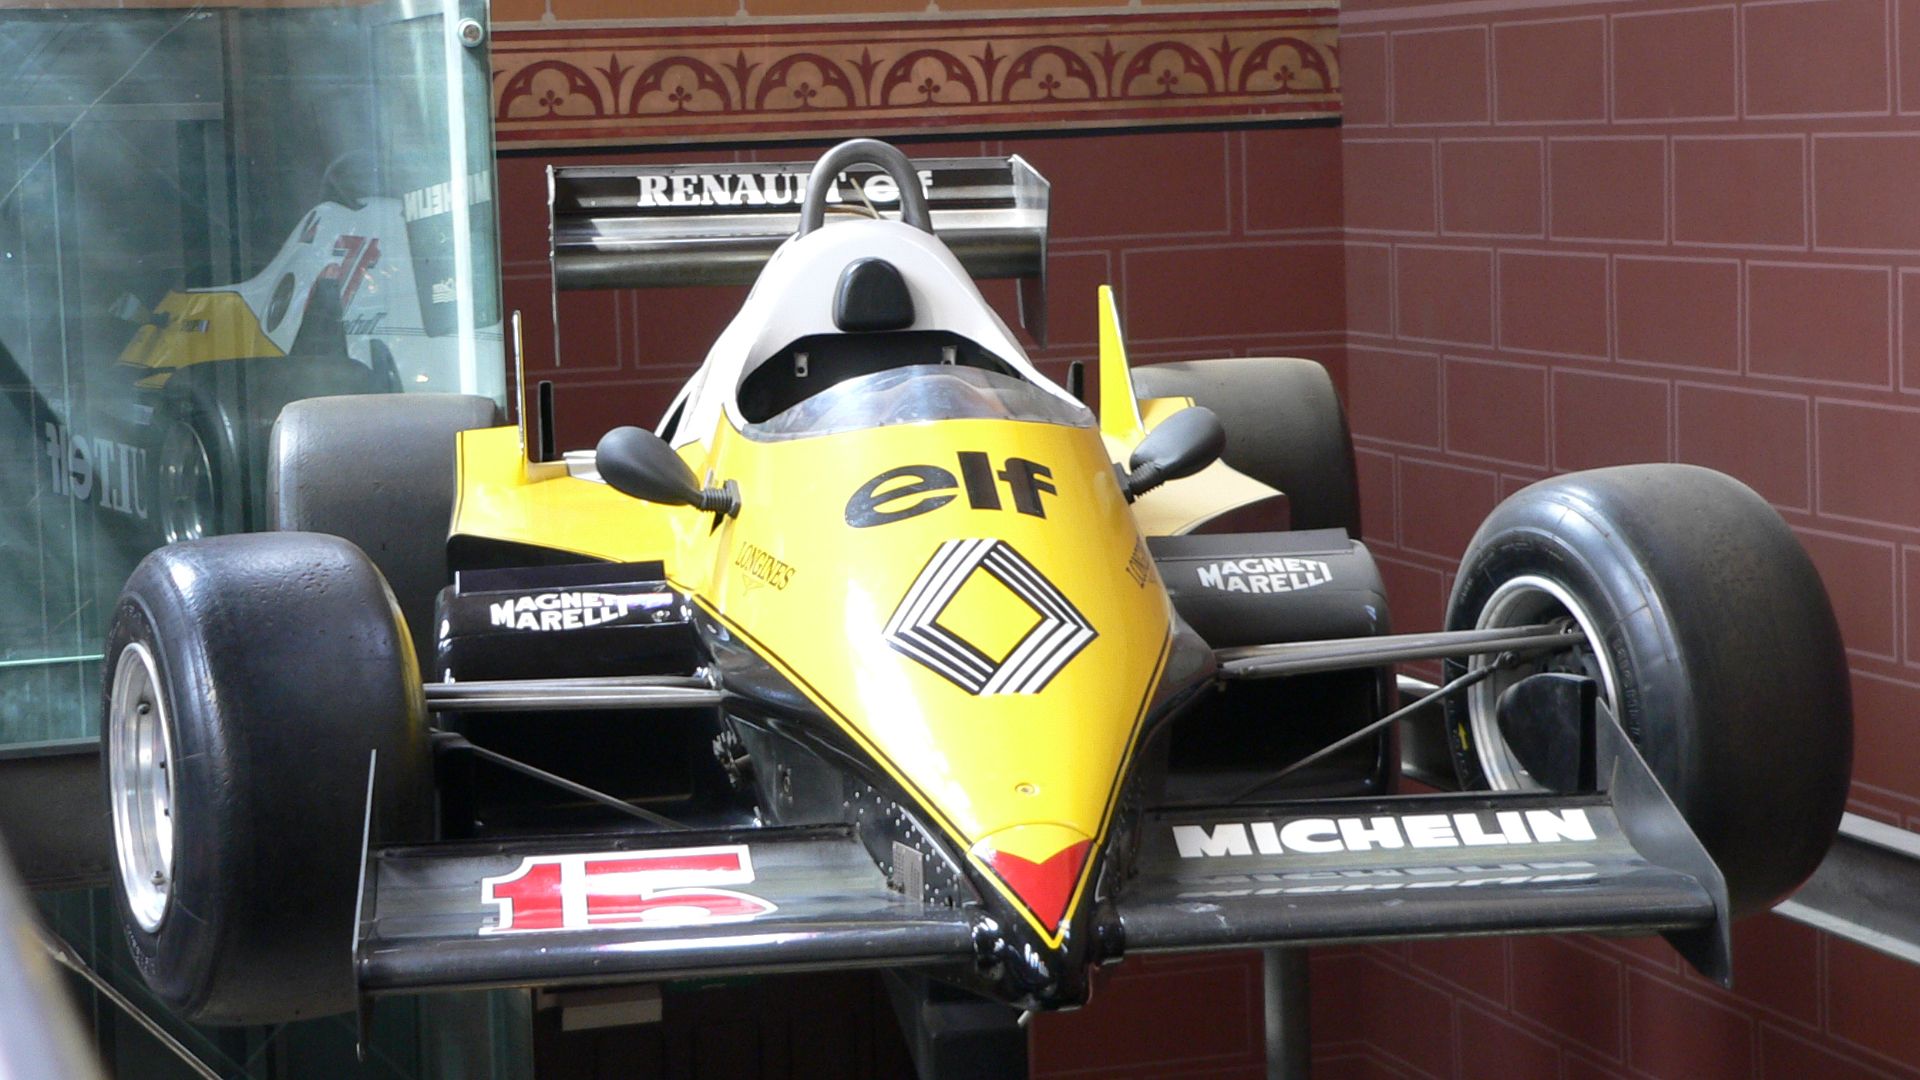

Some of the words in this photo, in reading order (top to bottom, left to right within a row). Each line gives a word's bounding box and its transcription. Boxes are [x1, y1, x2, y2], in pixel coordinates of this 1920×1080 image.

[863, 170, 933, 202] ef
[844, 451, 1058, 528] elf
[735, 541, 796, 591] LONGINES
[1196, 558, 1333, 583] MAGNETI
[1197, 564, 1333, 593] MARELLI
[490, 601, 628, 631] MARELLI
[1172, 808, 1597, 859] MICHELIN
[479, 844, 779, 936] 15
